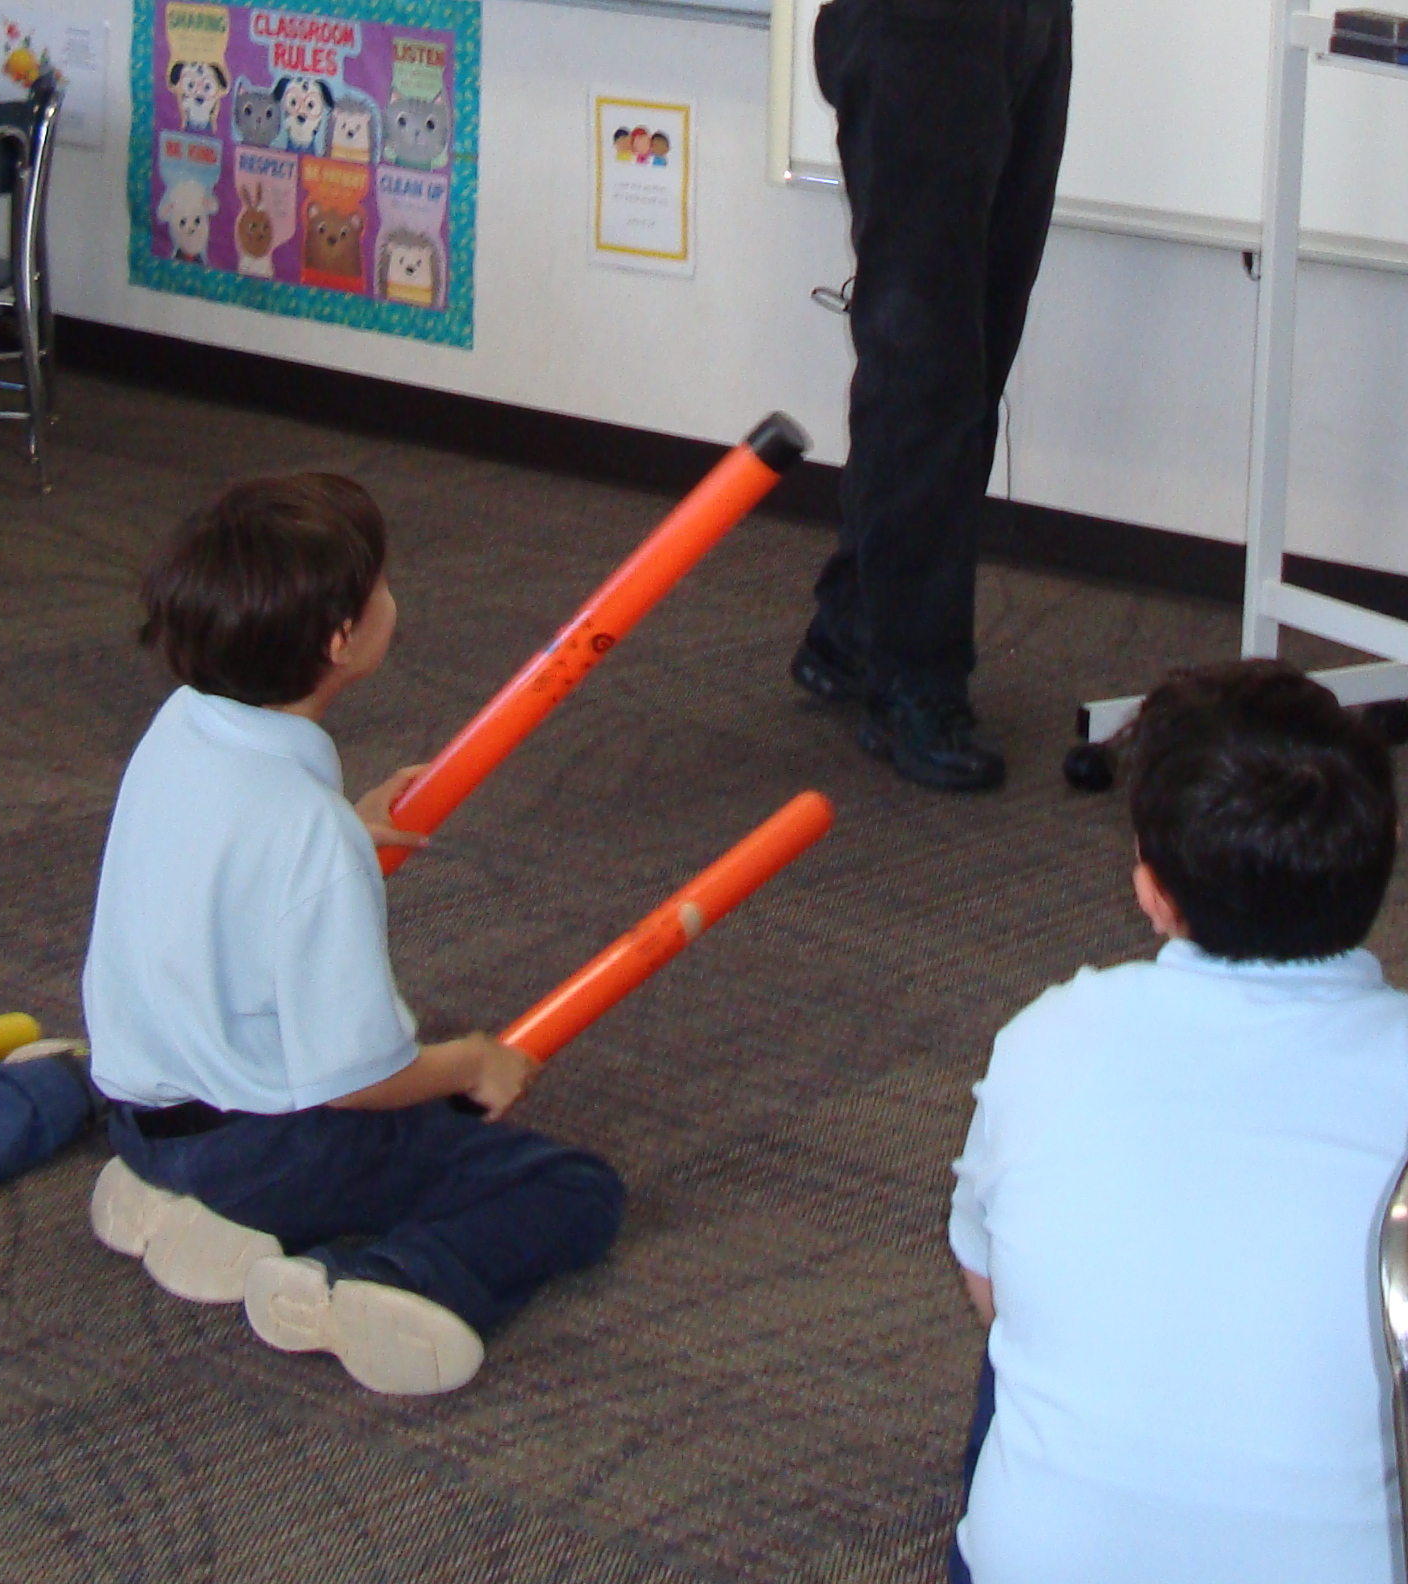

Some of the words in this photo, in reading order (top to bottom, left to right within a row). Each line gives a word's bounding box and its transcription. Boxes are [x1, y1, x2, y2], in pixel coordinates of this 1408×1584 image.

[253, 13, 355, 48] CLASSROOM
[274, 43, 338, 76] RULES
[394, 43, 447, 67] LISTEN
